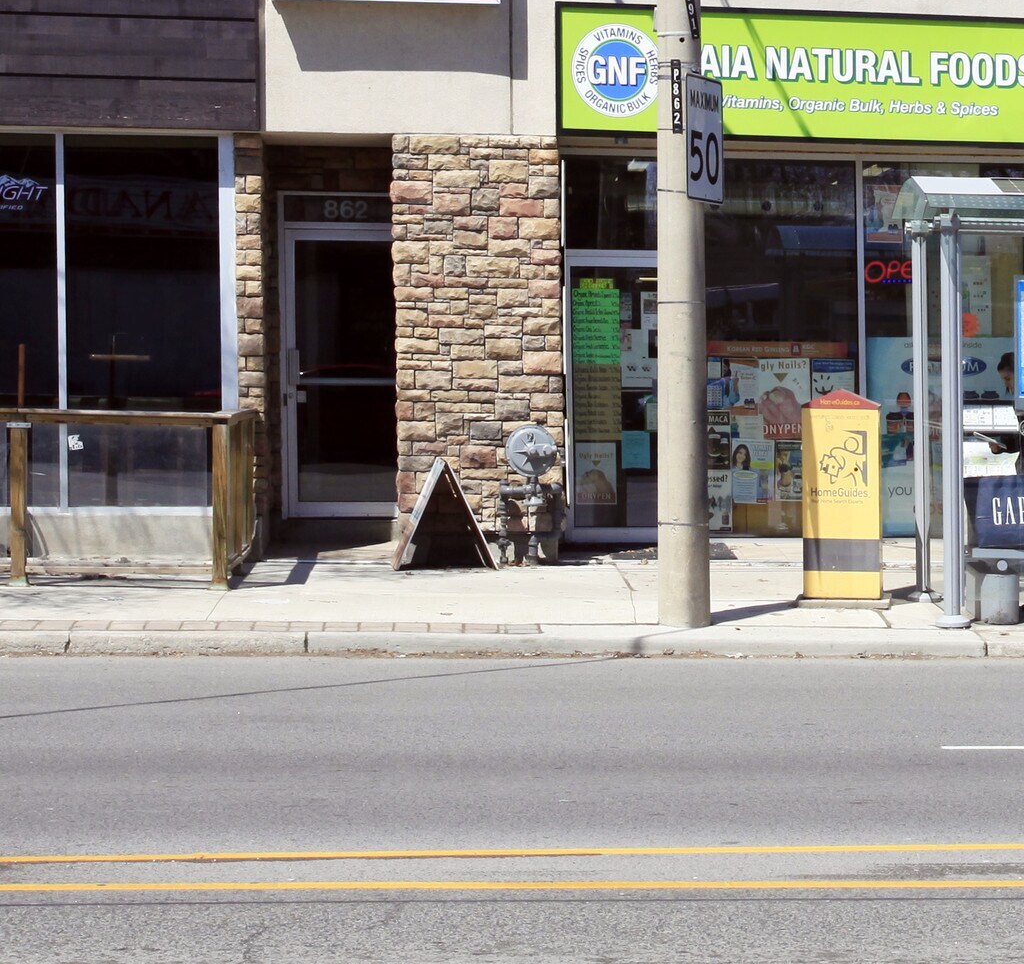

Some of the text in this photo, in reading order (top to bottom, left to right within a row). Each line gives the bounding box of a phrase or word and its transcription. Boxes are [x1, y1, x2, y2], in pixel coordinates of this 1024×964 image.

[593, 27, 643, 45] VITAMINS
[575, 47, 589, 84] SPICES
[587, 54, 647, 87] GNF
[700, 44, 757, 80] AIA
[765, 46, 922, 85] NATURAL
[584, 89, 652, 114] ORGANIC BULK
[690, 89, 720, 113] MAXIMUM
[788, 96, 845, 114] Organic
[849, 97, 886, 114] Bulk,
[888, 99, 932, 115] Herbs
[936, 101, 947, 115] &
[950, 102, 998, 119] Spices
[690, 130, 720, 185] 50
[323, 199, 368, 220] 862
[865, 260, 912, 284] OPE
[760, 361, 775, 372] gly
[778, 360, 807, 371] Nails?
[708, 416, 729, 424] MACA
[810, 486, 869, 498] HomeGuides
[888, 486, 913, 498] you
